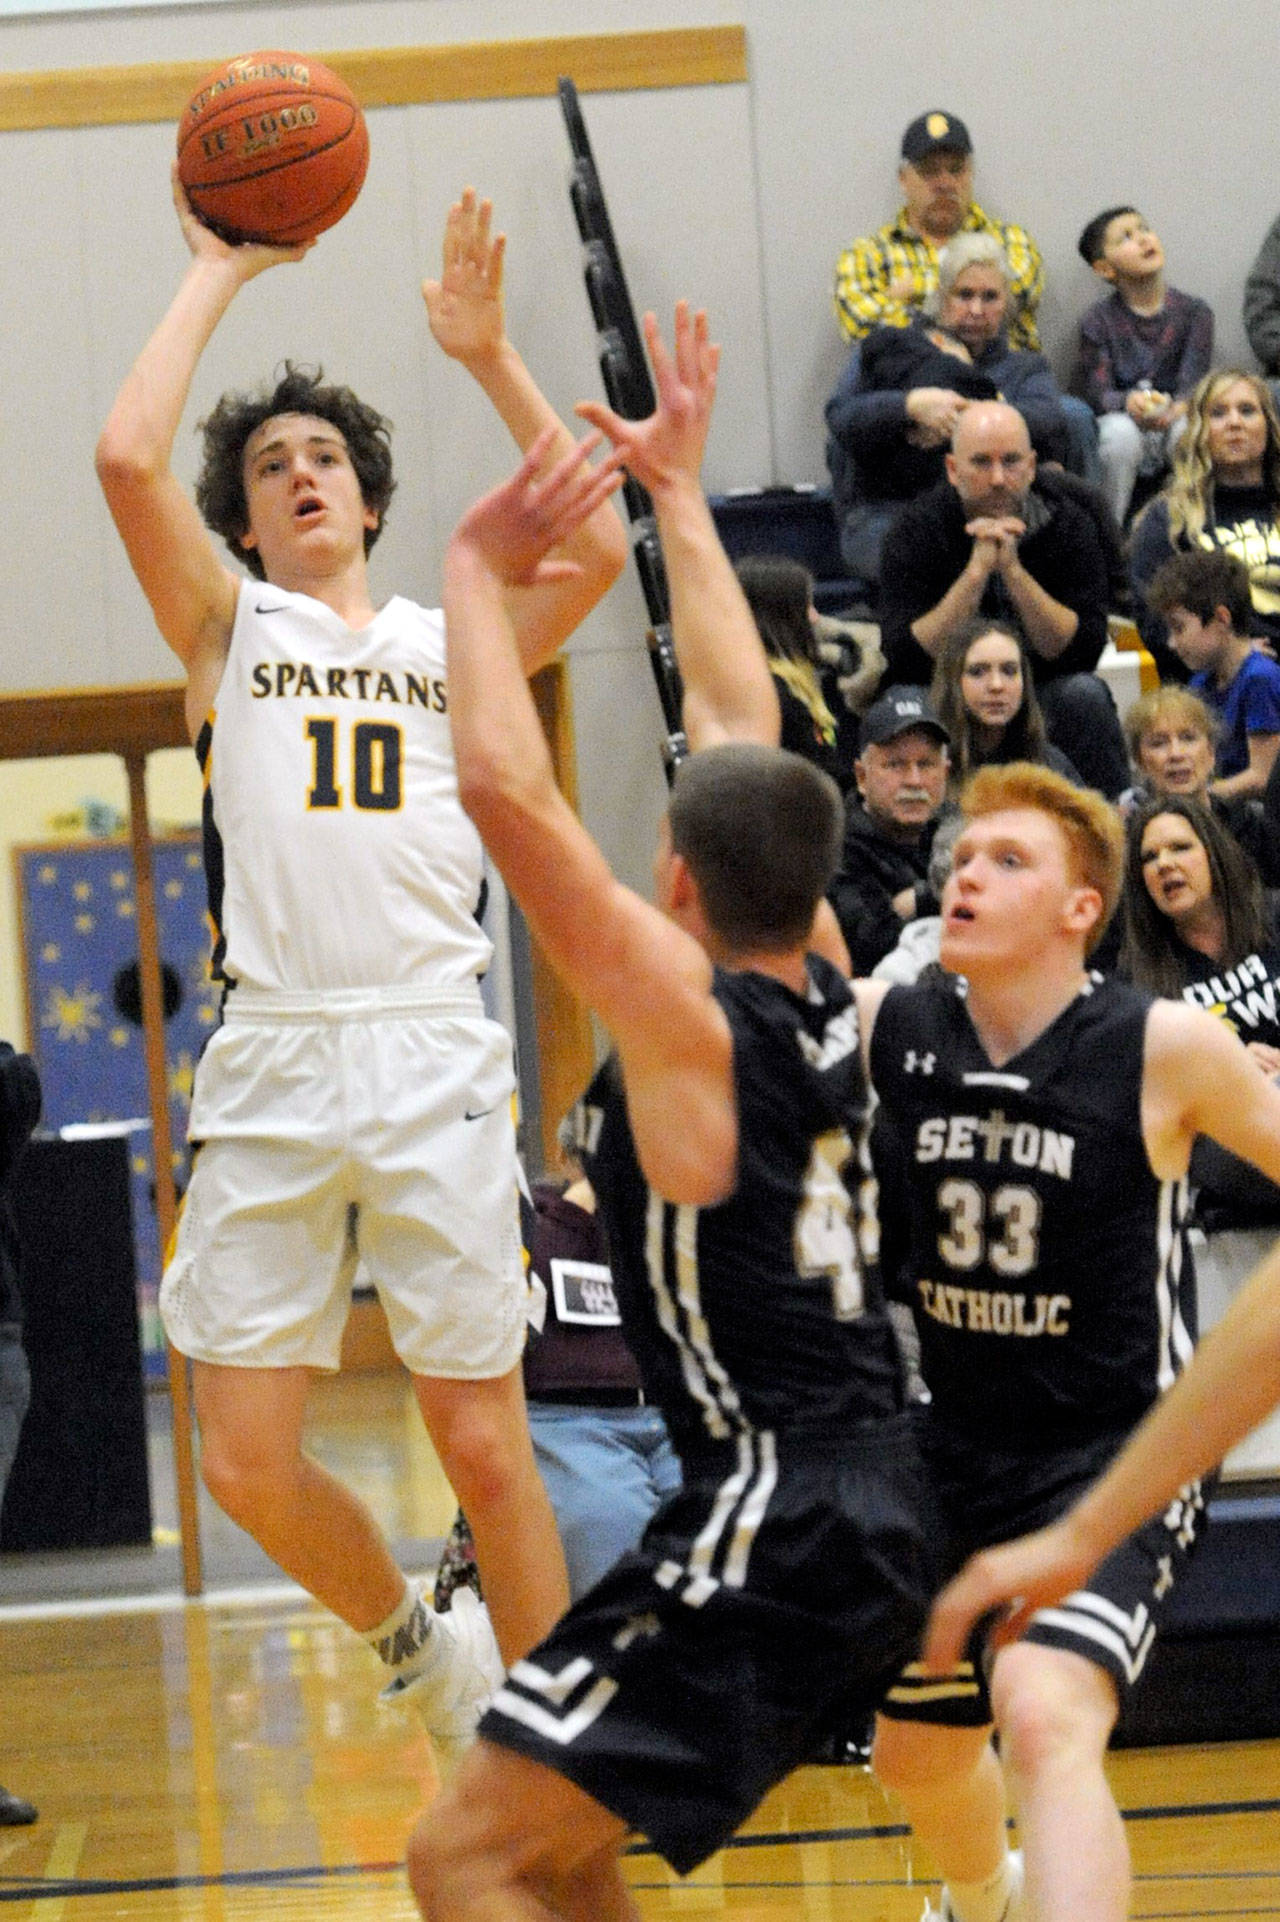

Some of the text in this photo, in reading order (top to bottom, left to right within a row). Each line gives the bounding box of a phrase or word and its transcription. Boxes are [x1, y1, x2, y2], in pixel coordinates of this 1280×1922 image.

[242, 102, 318, 140] 1000
[251, 662, 447, 714] SPARTANS
[303, 715, 405, 812] 10
[916, 1109, 1076, 1180] SETON
[937, 1177, 1042, 1277] 33
[918, 1278, 1072, 1337] CATHOLIC
